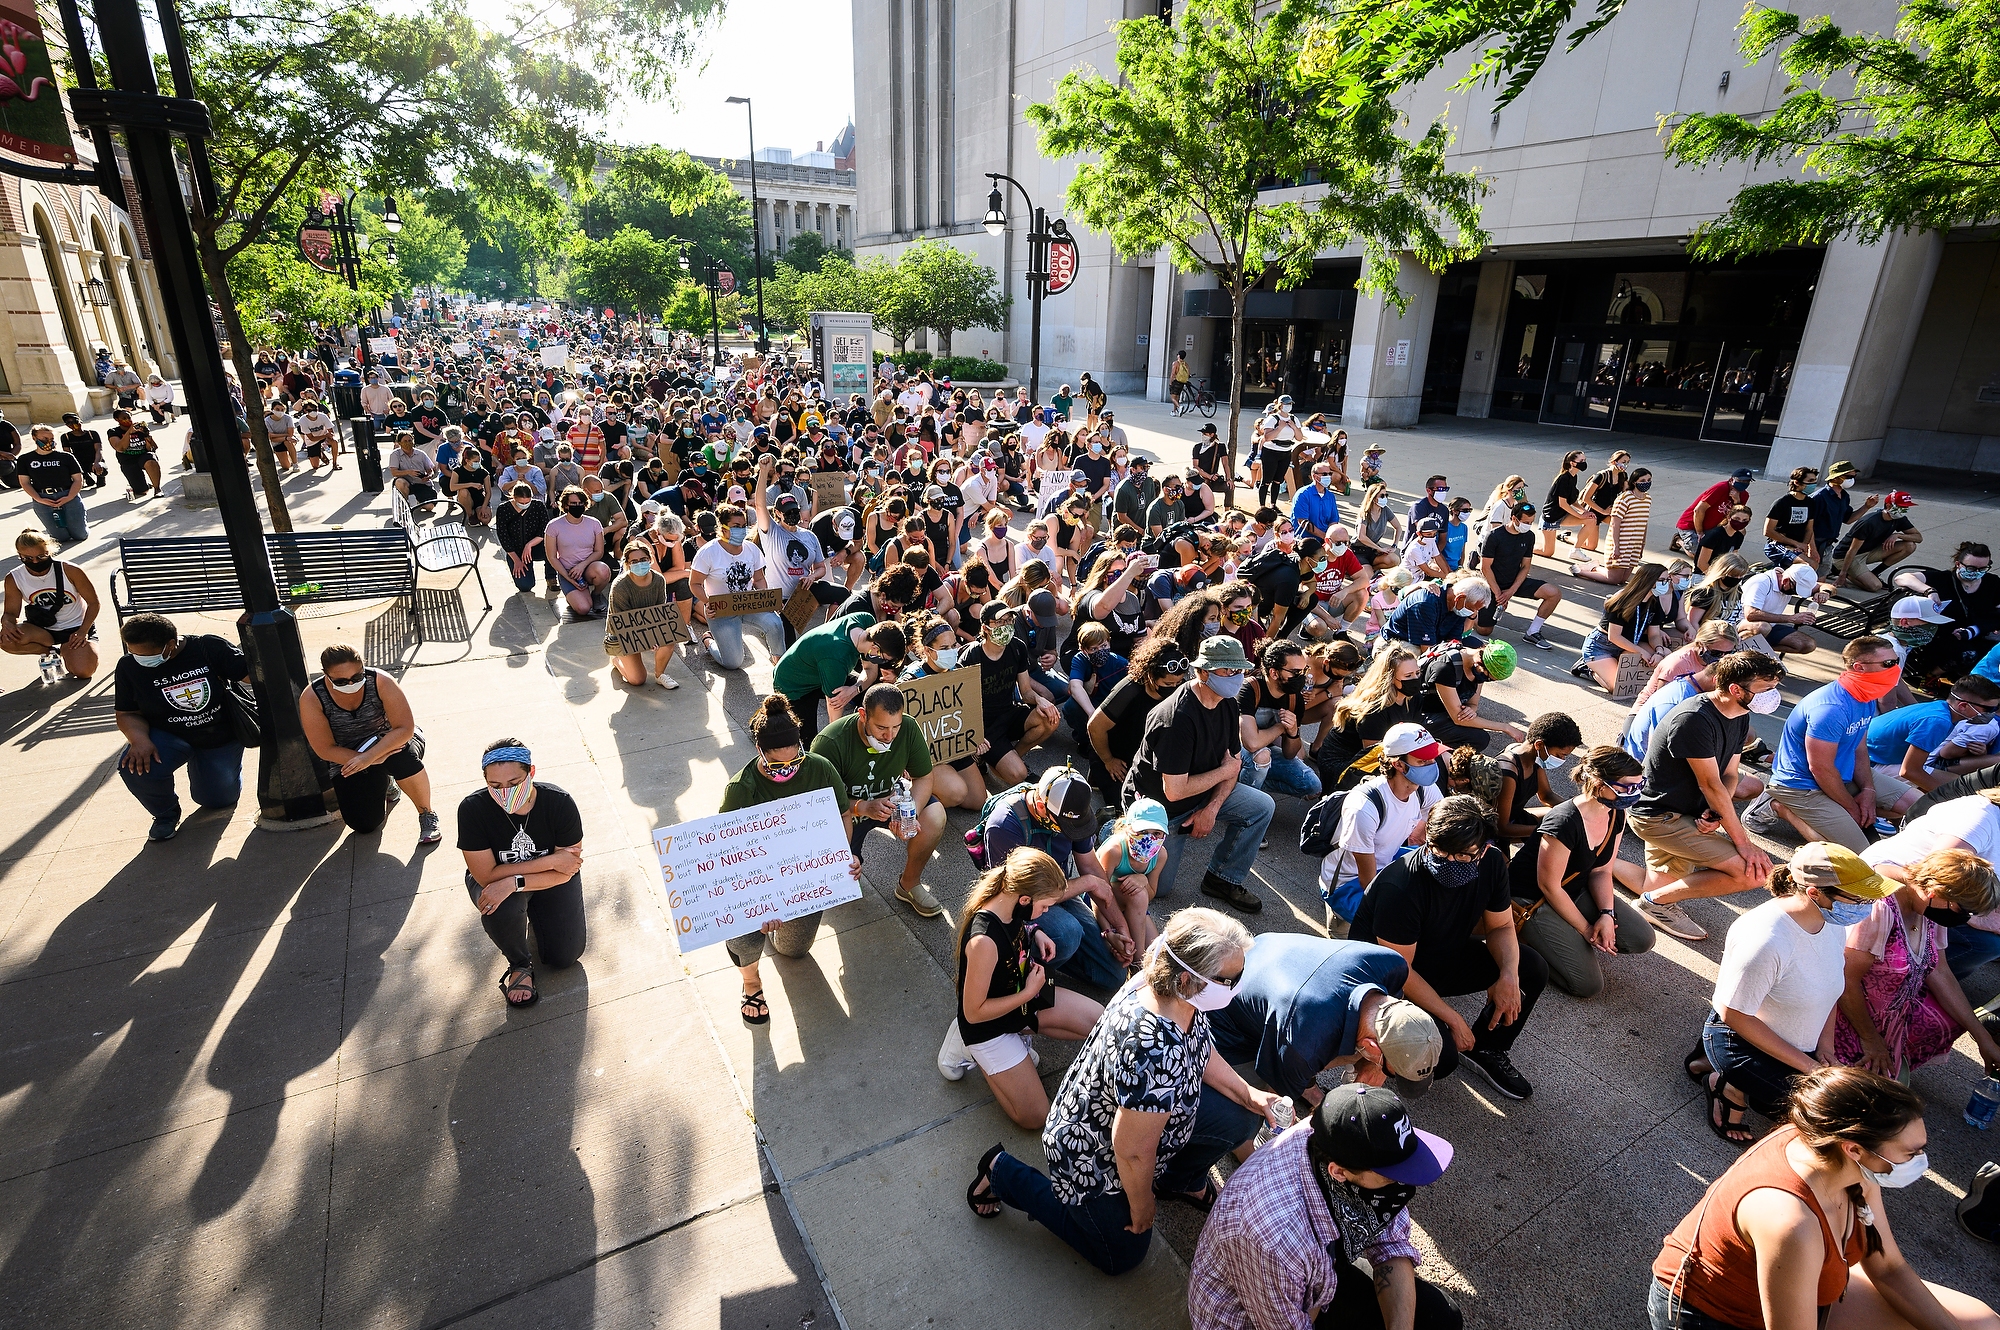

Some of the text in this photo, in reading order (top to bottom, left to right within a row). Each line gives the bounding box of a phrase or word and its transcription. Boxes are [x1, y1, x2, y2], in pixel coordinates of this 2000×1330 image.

[1051, 250, 1059, 282] BLOCK
[1059, 244, 1071, 283] 700
[833, 346, 849, 355] STUFF
[835, 337, 846, 345] GET
[709, 601, 728, 611] END
[732, 591, 775, 602] SYSTEMIC
[732, 600, 777, 611] OPPRESION
[612, 604, 678, 630] BLACK LIVES
[619, 621, 687, 653] MATTER
[1621, 655, 1650, 668] BLA
[153, 677, 171, 686] S.S.
[171, 666, 210, 682] MORRIS
[1618, 670, 1653, 682] LIVES
[902, 682, 963, 718] BLACK
[1617, 684, 1646, 696] MAT
[167, 711, 209, 723] COMMUNITY
[185, 715, 214, 727] CHURCH
[923, 710, 963, 741] IVES
[930, 729, 977, 762] ATTER
[674, 830, 704, 843] million
[709, 816, 743, 831] students
[746, 813, 760, 822] are
[775, 801, 802, 814] schools
[806, 795, 814, 807] w/
[815, 795, 831, 805] cops
[677, 813, 787, 851] but NO COUNSELORS
[674, 857, 701, 871] million
[706, 845, 740, 860] students
[745, 838, 759, 847] are
[774, 825, 797, 838] schools
[800, 821, 809, 831] w/
[811, 819, 829, 829] cops
[662, 865, 675, 883] 3
[677, 845, 767, 879] but NO NURSES
[682, 881, 708, 896] million
[712, 872, 744, 886] students
[748, 868, 763, 877] are
[777, 854, 801, 866] schools
[804, 849, 813, 859] w/
[817, 847, 832, 857] cops
[684, 849, 850, 906] but NO SCHOOL PSYCHOLOGISTS
[668, 890, 682, 909] 6
[691, 872, 844, 924] million students are in schools w/ cops
[694, 885, 833, 934] but NO SOCIAL WORKERS
[675, 915, 692, 936] 10
